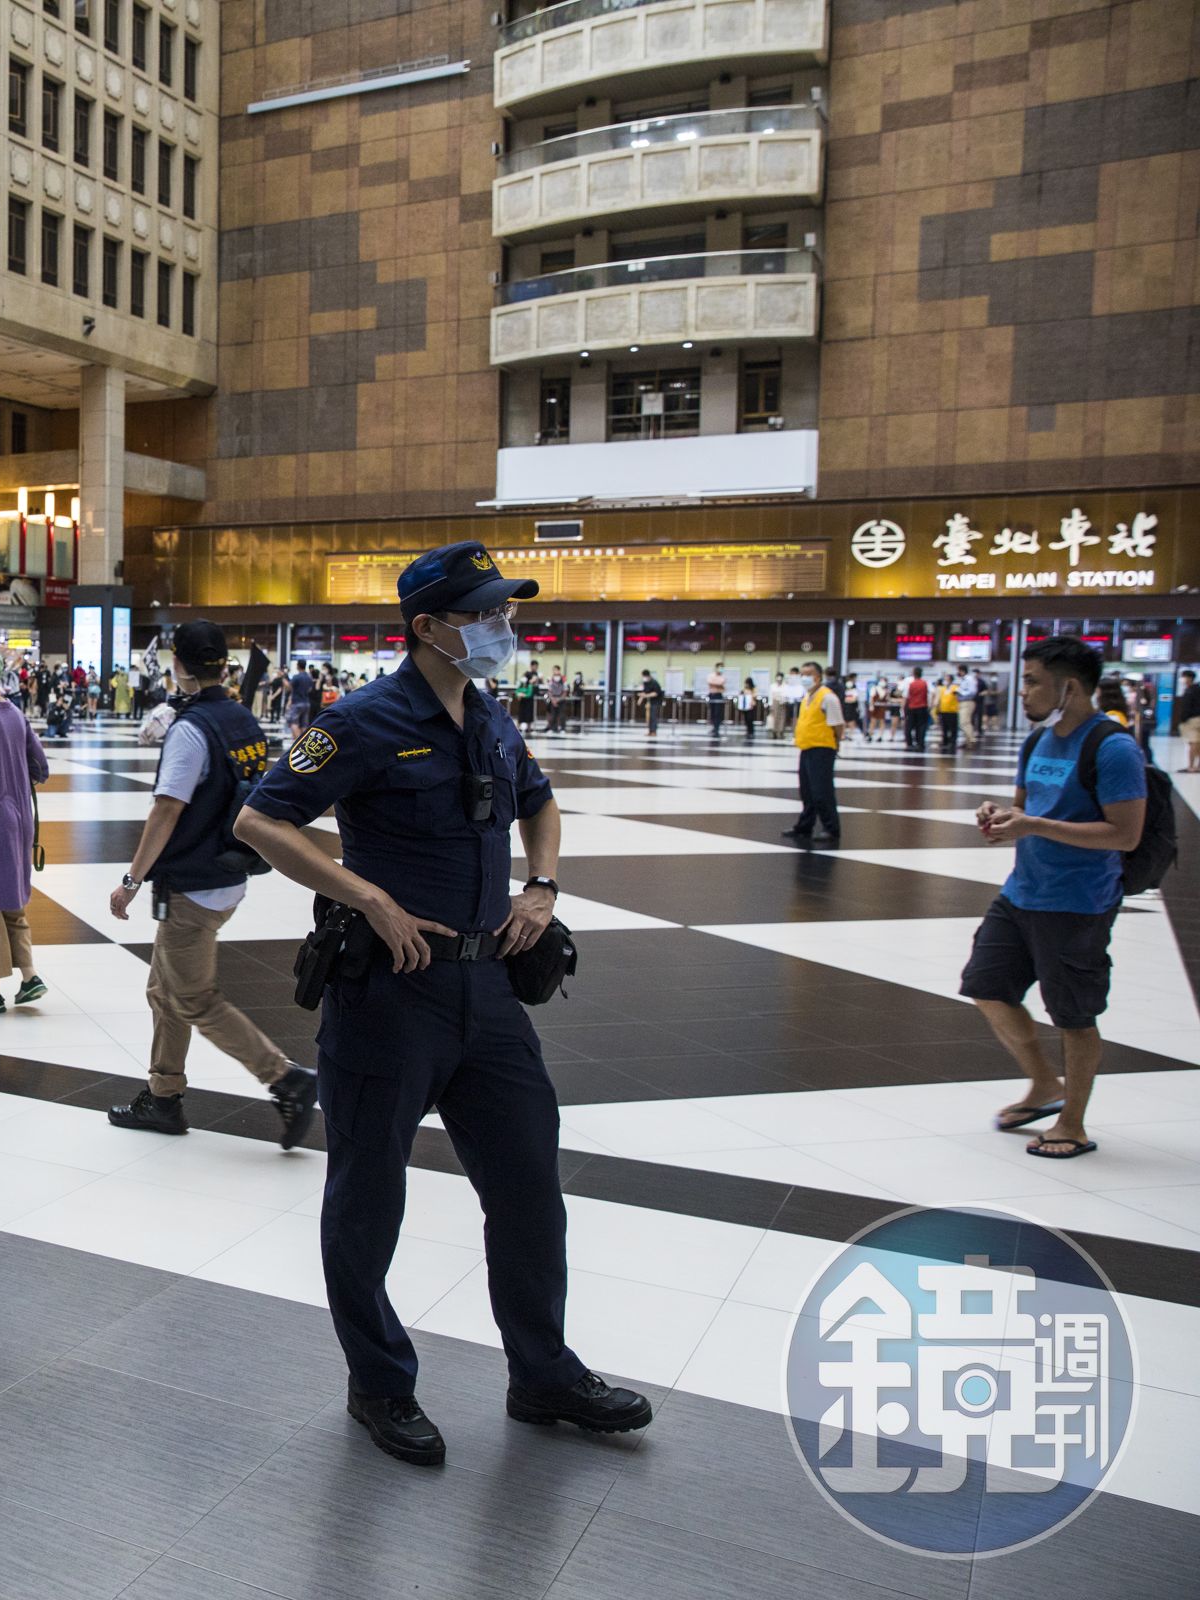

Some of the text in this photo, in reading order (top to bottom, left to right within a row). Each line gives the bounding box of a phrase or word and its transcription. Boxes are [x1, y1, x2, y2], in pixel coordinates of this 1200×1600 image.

[932, 508, 1158, 567] 臺北車站
[936, 569, 1154, 590] TAIPEI MAIN STATION
